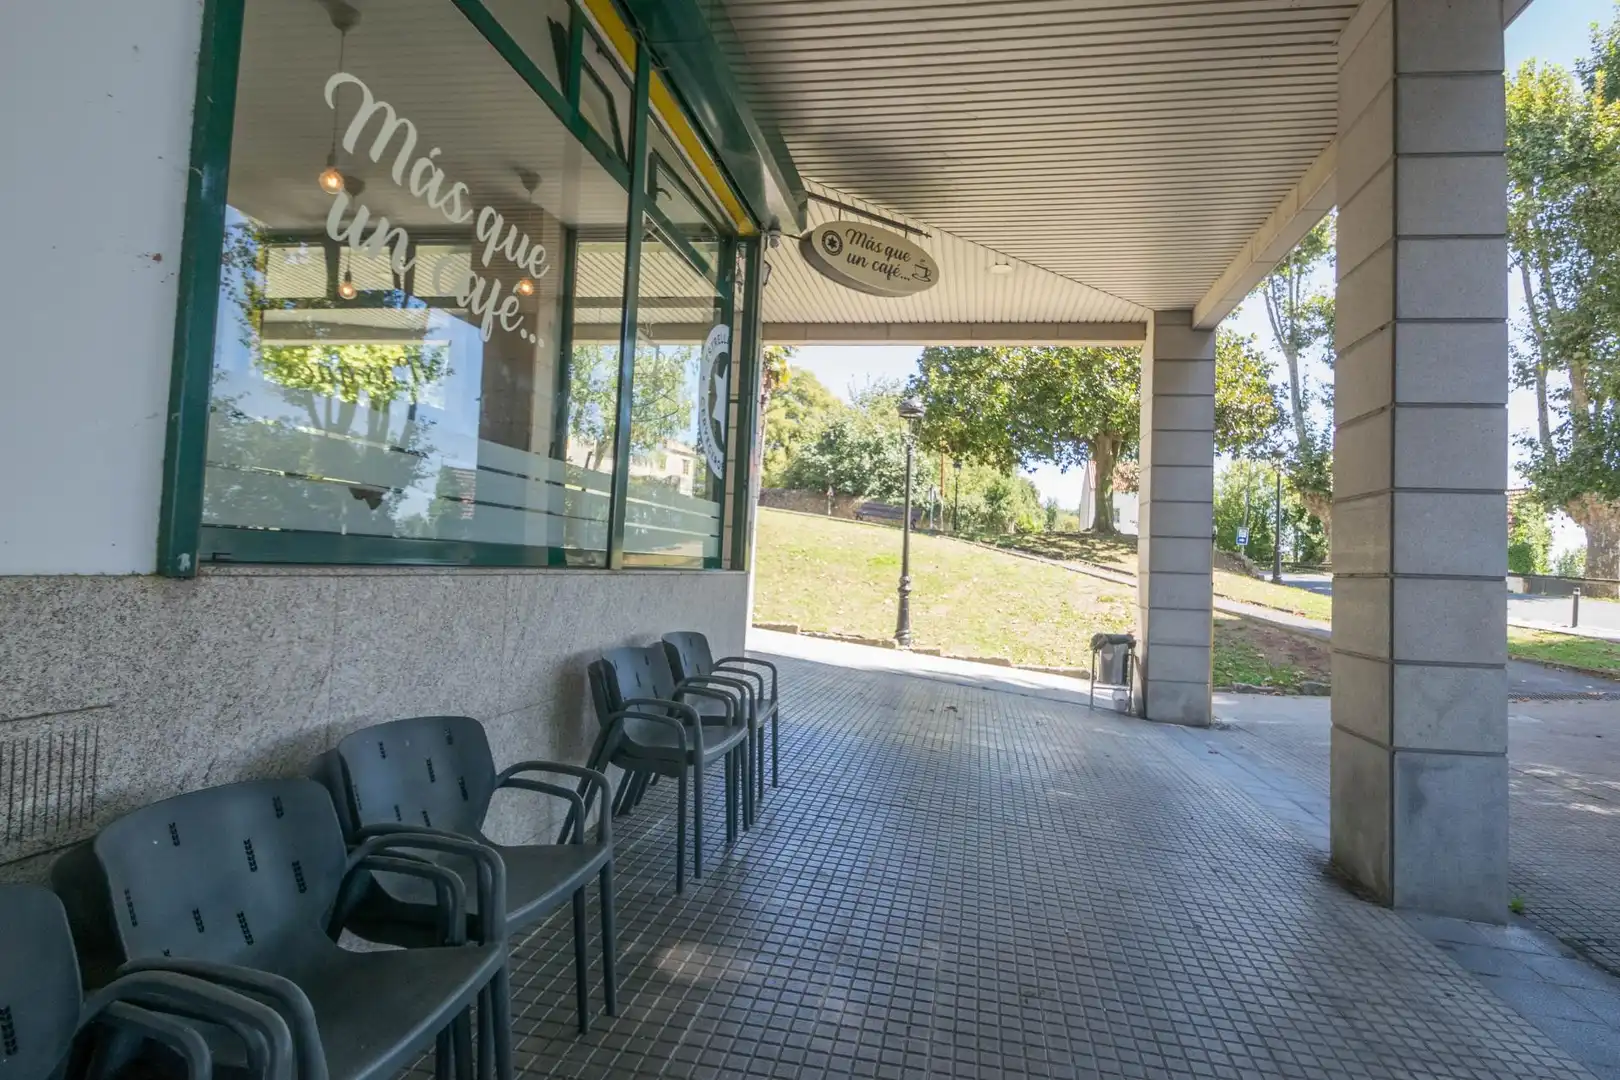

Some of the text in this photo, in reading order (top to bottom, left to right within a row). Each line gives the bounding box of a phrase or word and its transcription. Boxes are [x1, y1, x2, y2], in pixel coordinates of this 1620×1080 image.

[324, 72, 549, 278] Más que
[845, 228, 882, 253] Más
[884, 246, 911, 262] que
[326, 189, 545, 347] un café...
[846, 252, 910, 281] un café...
[705, 333, 729, 363] ESTRELL
